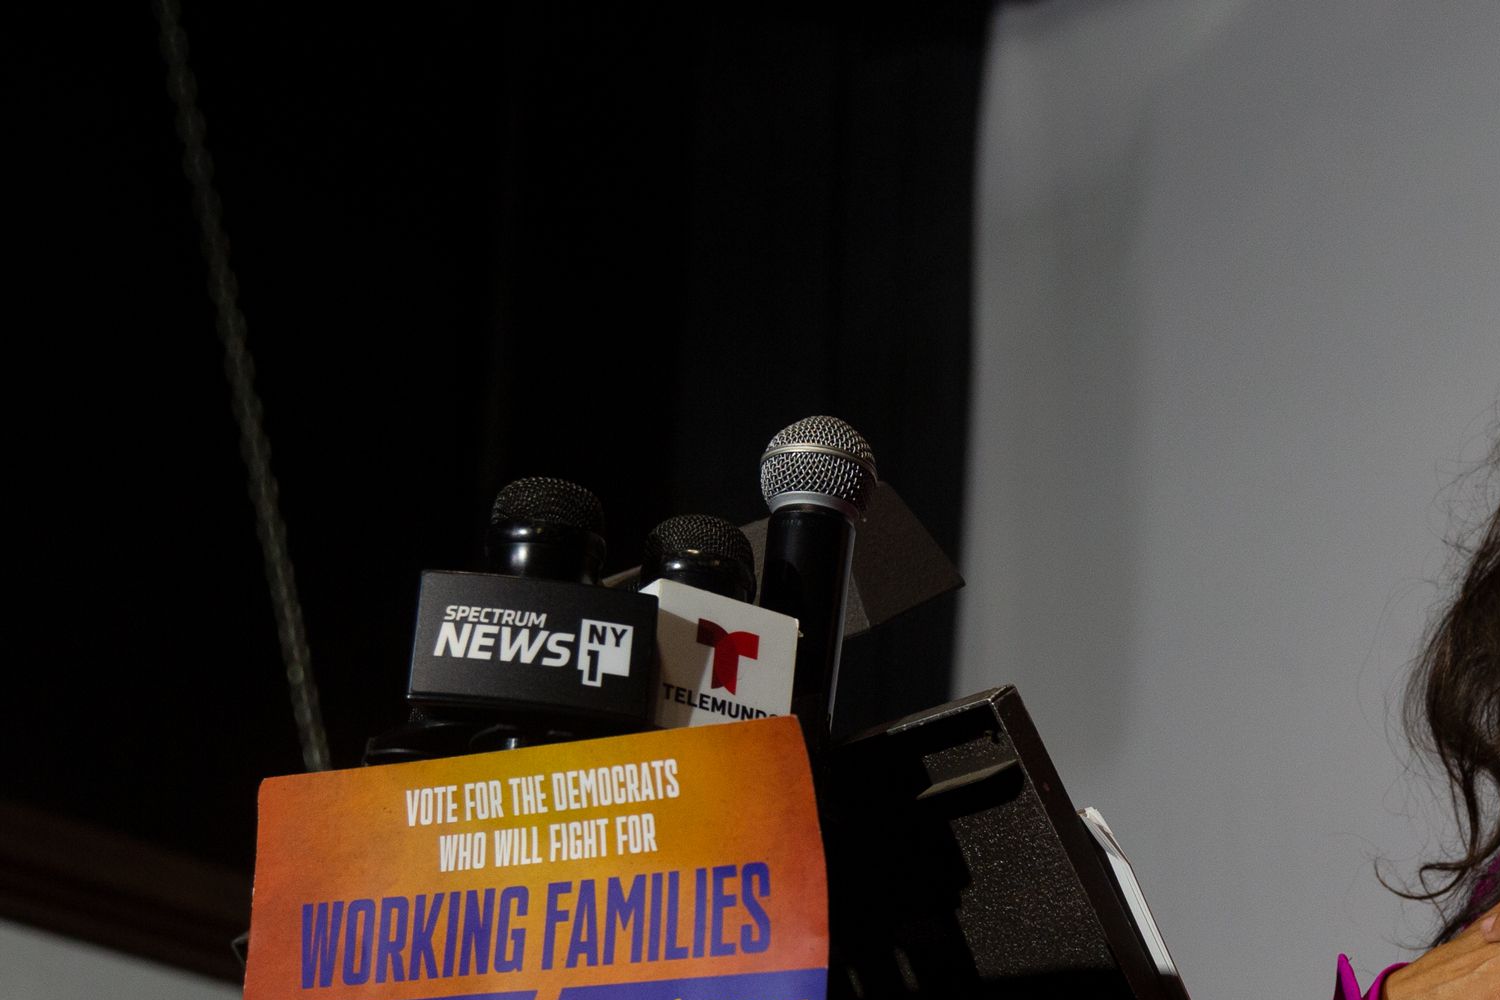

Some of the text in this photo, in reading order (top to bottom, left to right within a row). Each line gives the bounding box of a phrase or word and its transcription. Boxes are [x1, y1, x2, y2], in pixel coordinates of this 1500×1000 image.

[444, 605, 547, 628] SPECTRUM
[433, 622, 629, 667] NEWS NY
[662, 682, 778, 721] TELEMUND
[406, 759, 680, 827] VOTE FOR THE DEMOCRATS
[439, 813, 658, 872] WHO WILL FIGHT FOR
[300, 862, 772, 989] WORKING FAMILIES
